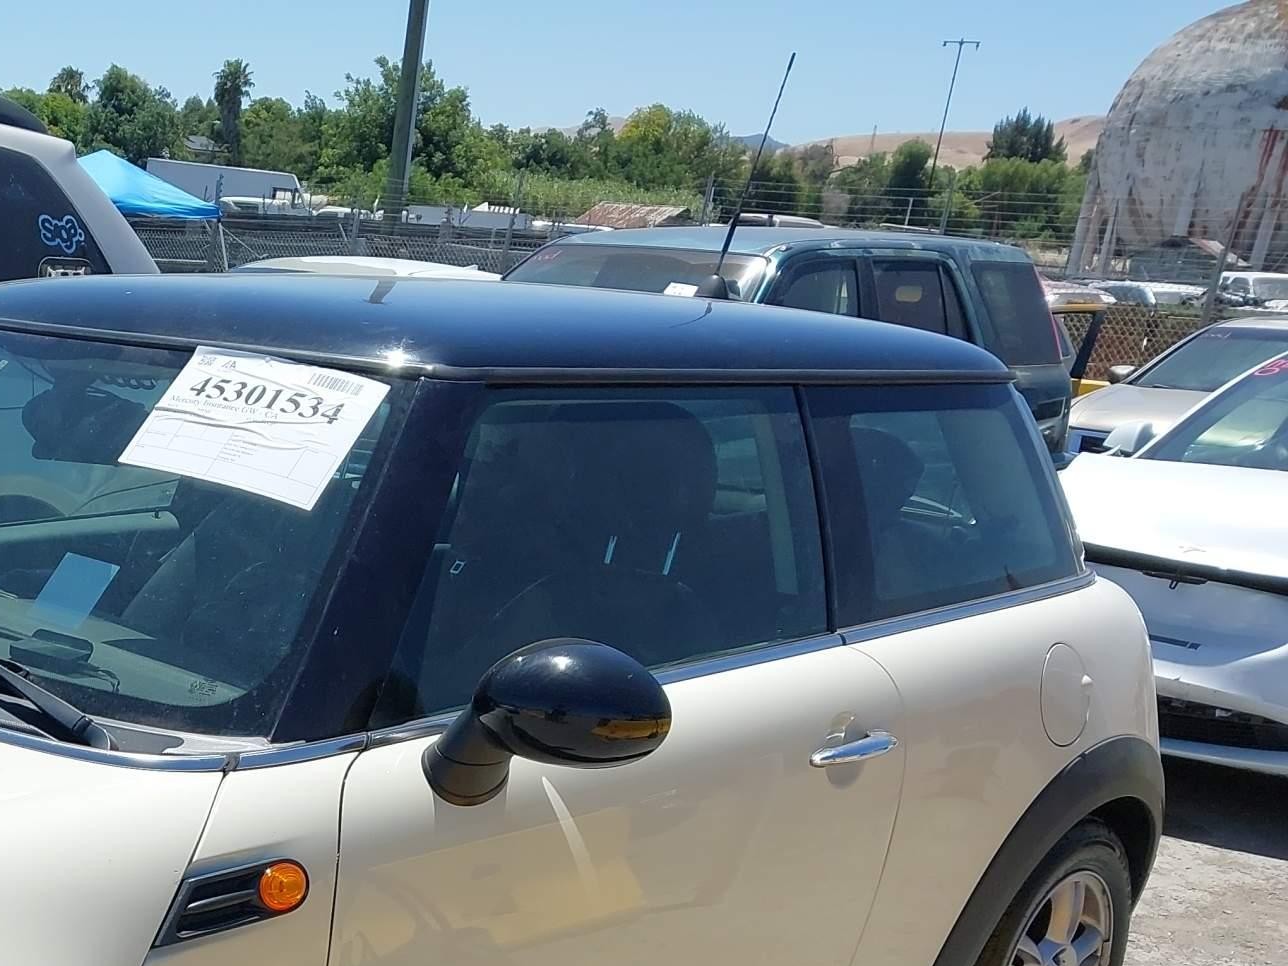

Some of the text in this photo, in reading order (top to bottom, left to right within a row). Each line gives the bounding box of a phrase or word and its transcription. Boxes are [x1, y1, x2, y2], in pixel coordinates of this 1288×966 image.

[171, 394, 200, 406] Mercury
[203, 398, 240, 412] Insurance
[190, 376, 345, 424] 45301534
